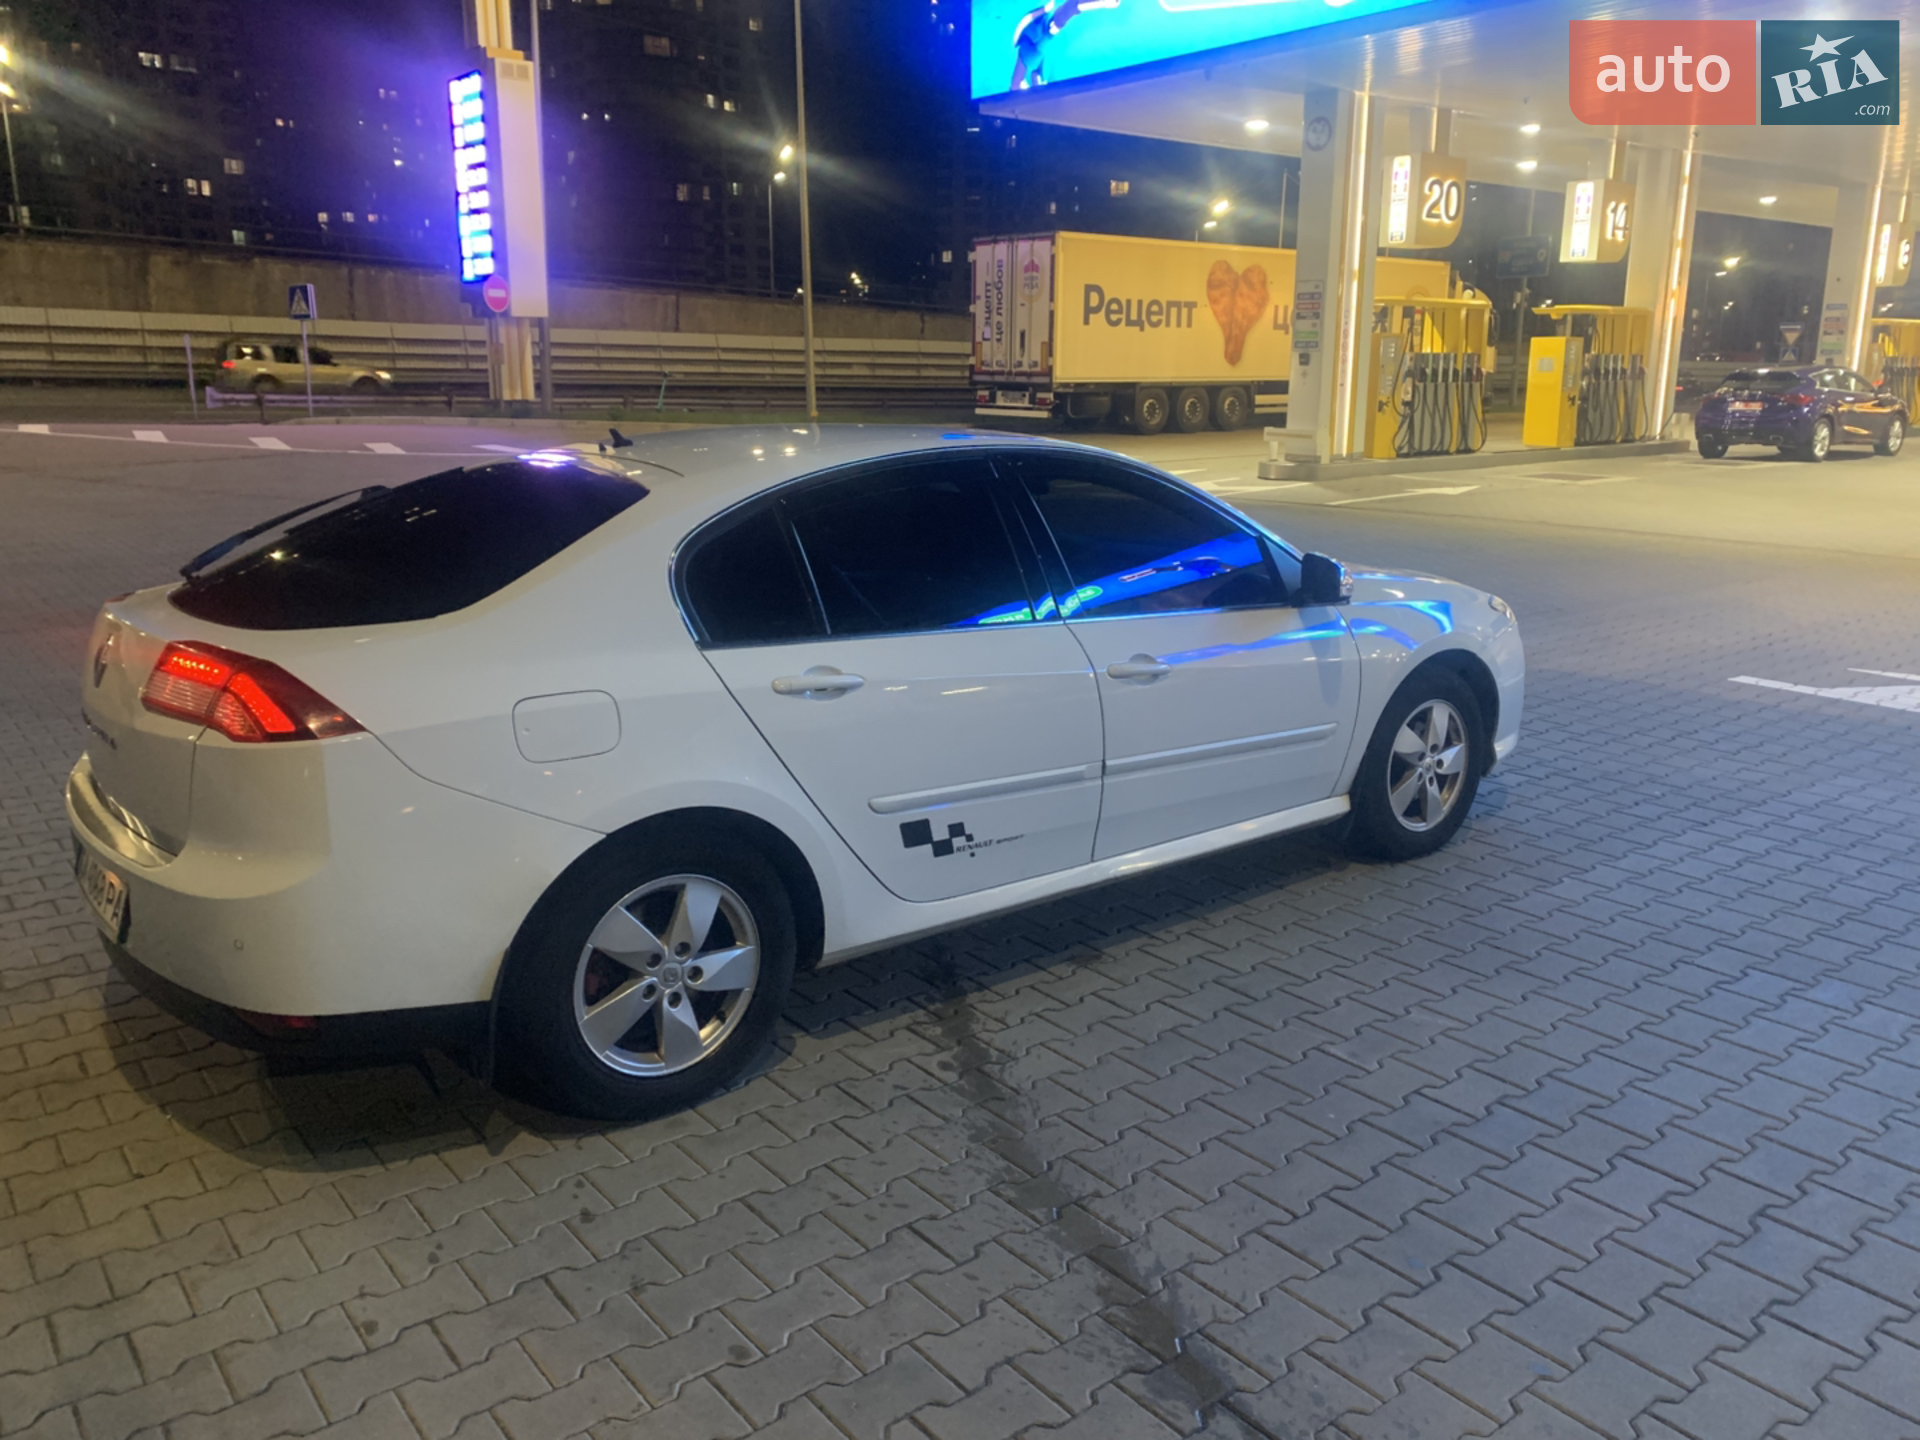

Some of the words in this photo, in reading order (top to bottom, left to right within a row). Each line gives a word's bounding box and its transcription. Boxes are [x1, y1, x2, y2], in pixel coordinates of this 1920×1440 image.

[1423, 177, 1462, 223] 20
[1607, 201, 1629, 241] 14
[1083, 284, 1198, 332] Рецепт
[1273, 305, 1294, 335] ц
[956, 839, 993, 853] RENAULT
